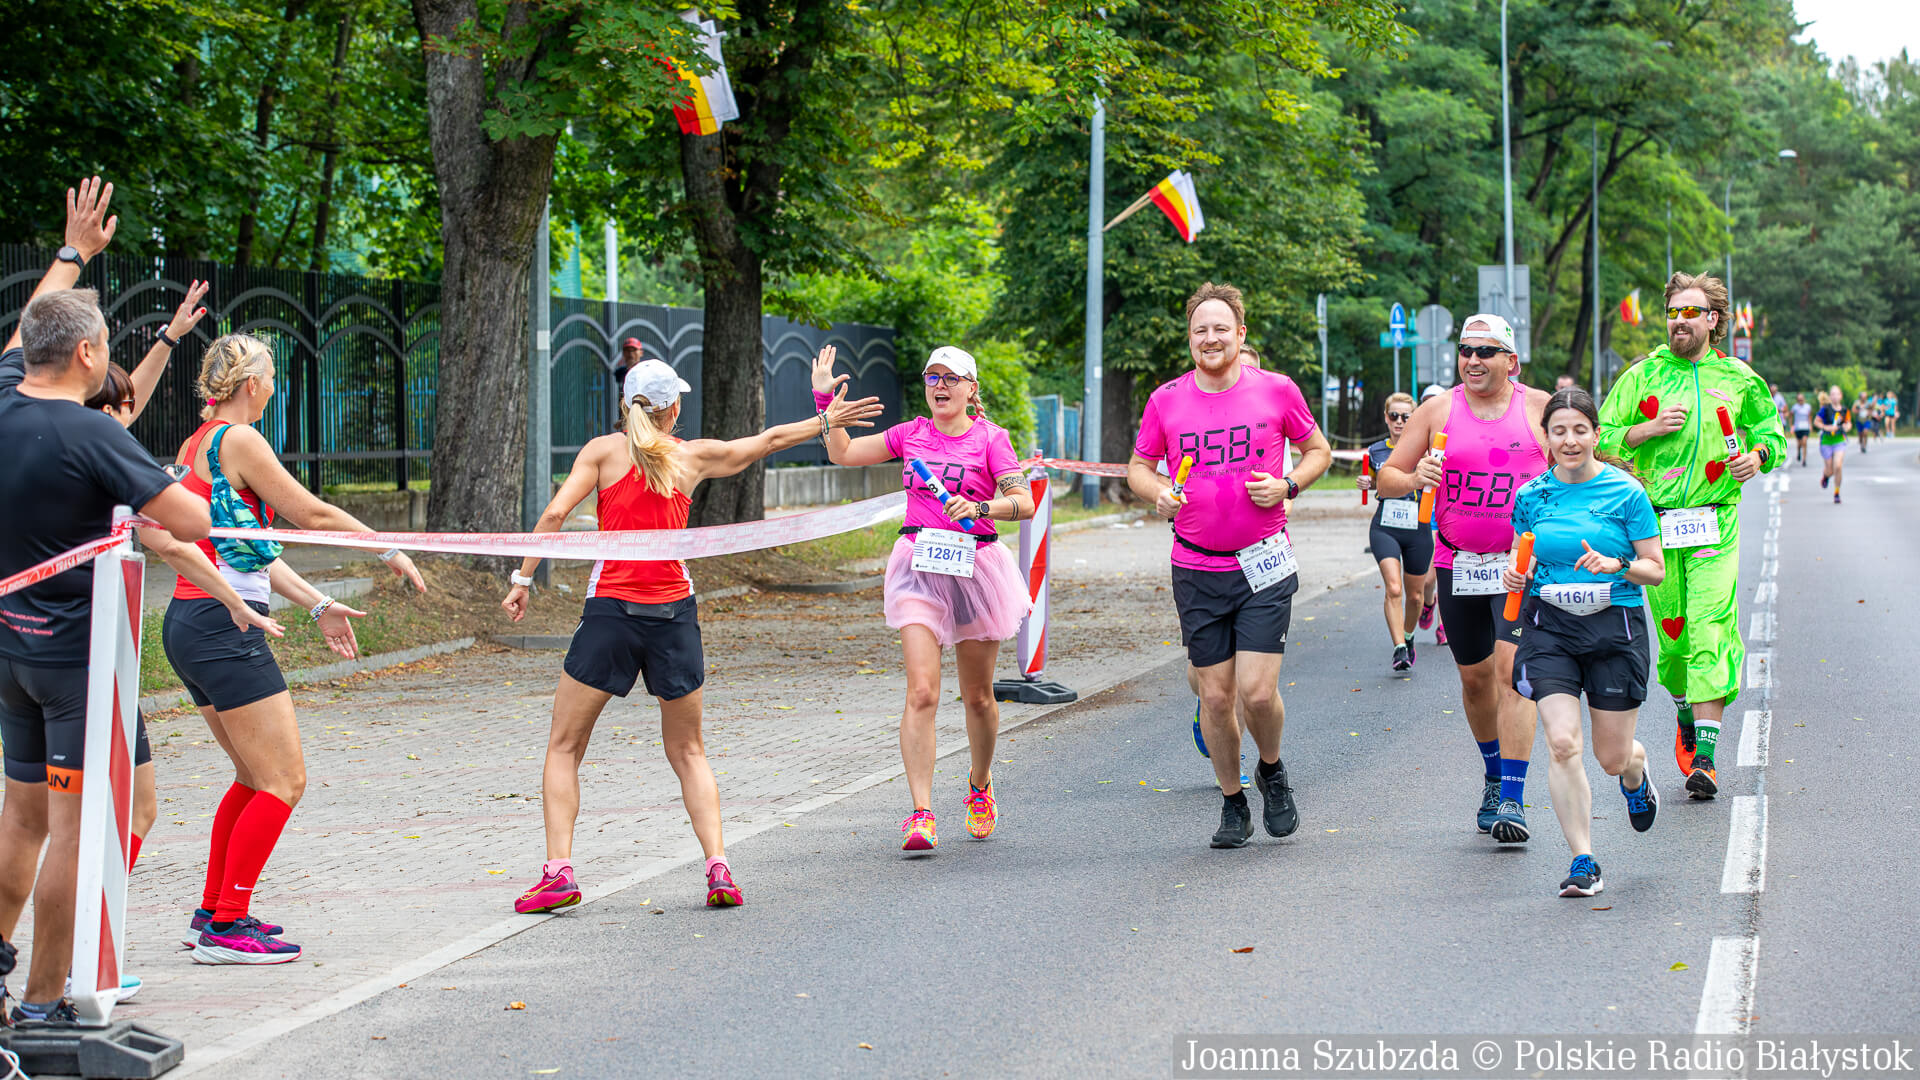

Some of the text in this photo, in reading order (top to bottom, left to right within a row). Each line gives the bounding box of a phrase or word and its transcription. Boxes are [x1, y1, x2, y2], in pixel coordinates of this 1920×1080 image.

[1673, 522, 1706, 536] 133/1
[927, 546, 962, 562] 128/1
[1256, 550, 1287, 574] 162/1
[1465, 568, 1499, 581] 146/1
[1554, 591, 1595, 604] 116/1
